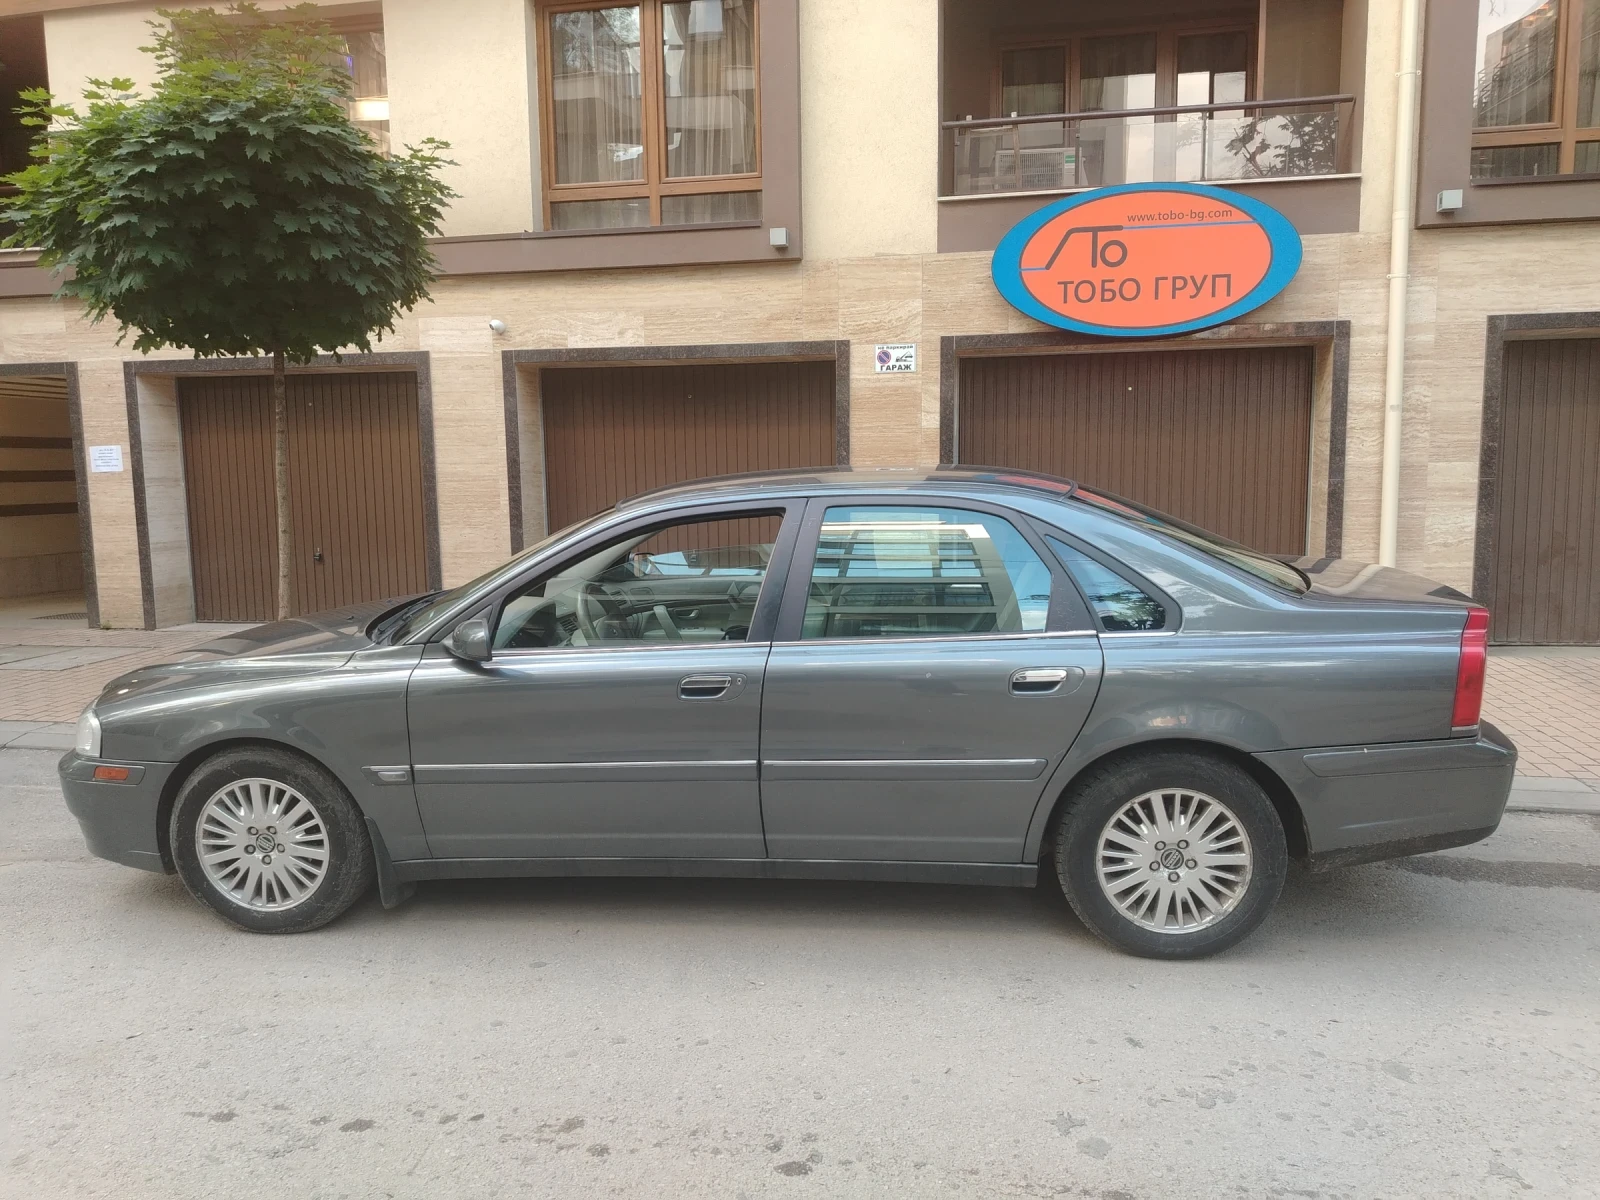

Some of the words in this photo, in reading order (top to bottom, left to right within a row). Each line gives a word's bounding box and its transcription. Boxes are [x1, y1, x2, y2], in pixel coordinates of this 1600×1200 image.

[1127, 209, 1232, 222] www.tobo-bg.com
[1057, 277, 1141, 304] ТОБО
[1154, 274, 1232, 300] ГРУП
